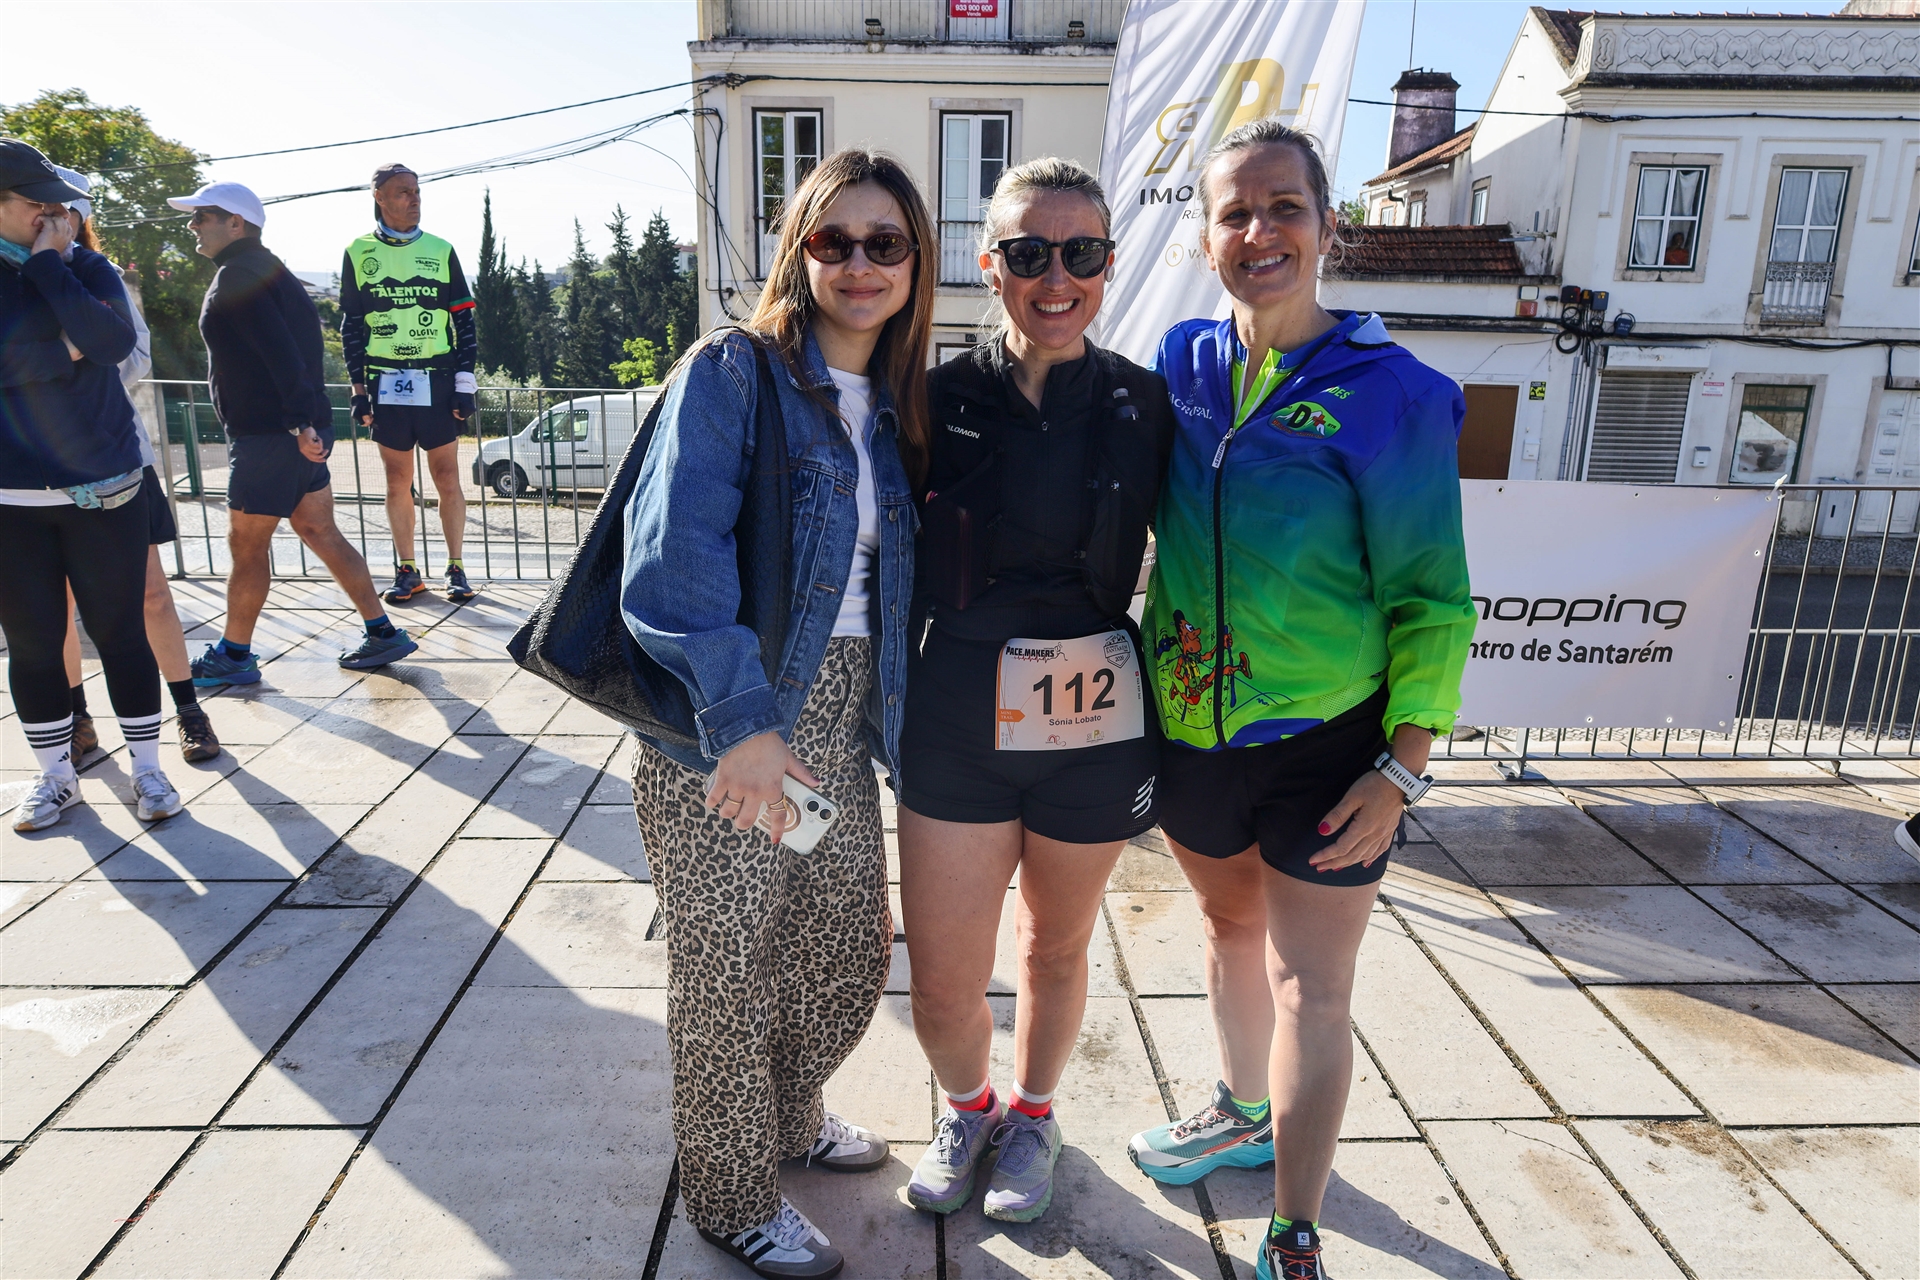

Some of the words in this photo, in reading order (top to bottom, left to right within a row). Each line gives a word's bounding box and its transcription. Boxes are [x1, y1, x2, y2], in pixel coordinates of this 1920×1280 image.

[391, 297, 417, 305] TEAM
[394, 379, 414, 393] 54
[1520, 638, 1552, 661] de
[1556, 638, 1673, 664] Santarém
[1033, 668, 1115, 715] 112
[1049, 717, 1073, 726] Sónia
[1075, 714, 1102, 724] Lobato
